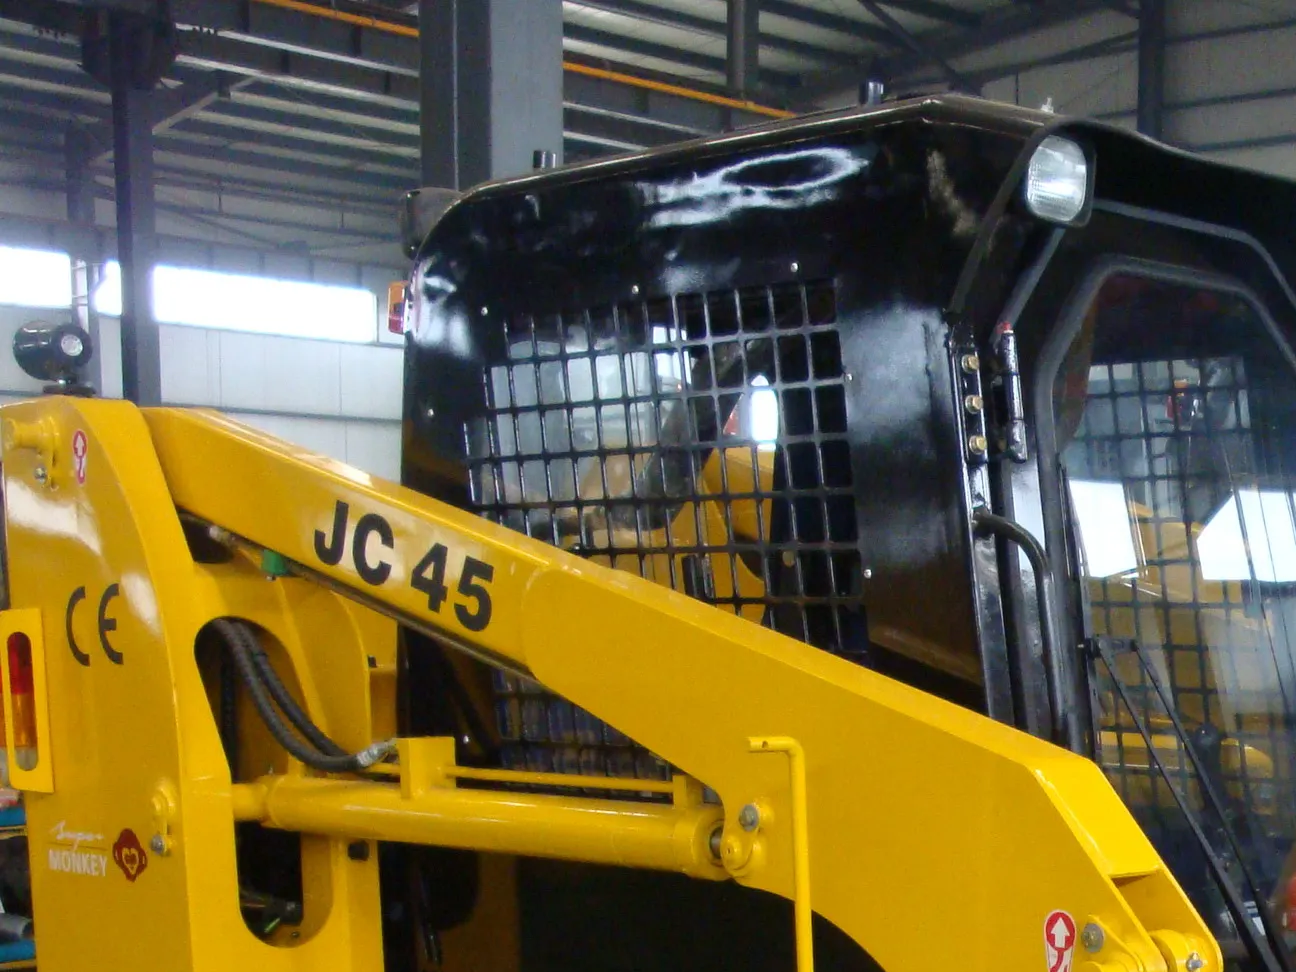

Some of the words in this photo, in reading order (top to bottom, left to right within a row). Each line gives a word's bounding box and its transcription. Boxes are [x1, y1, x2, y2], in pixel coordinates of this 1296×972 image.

[314, 500, 395, 586] JC
[410, 543, 495, 632] 45
[66, 583, 124, 667] CE
[48, 848, 107, 877] MONKEY
